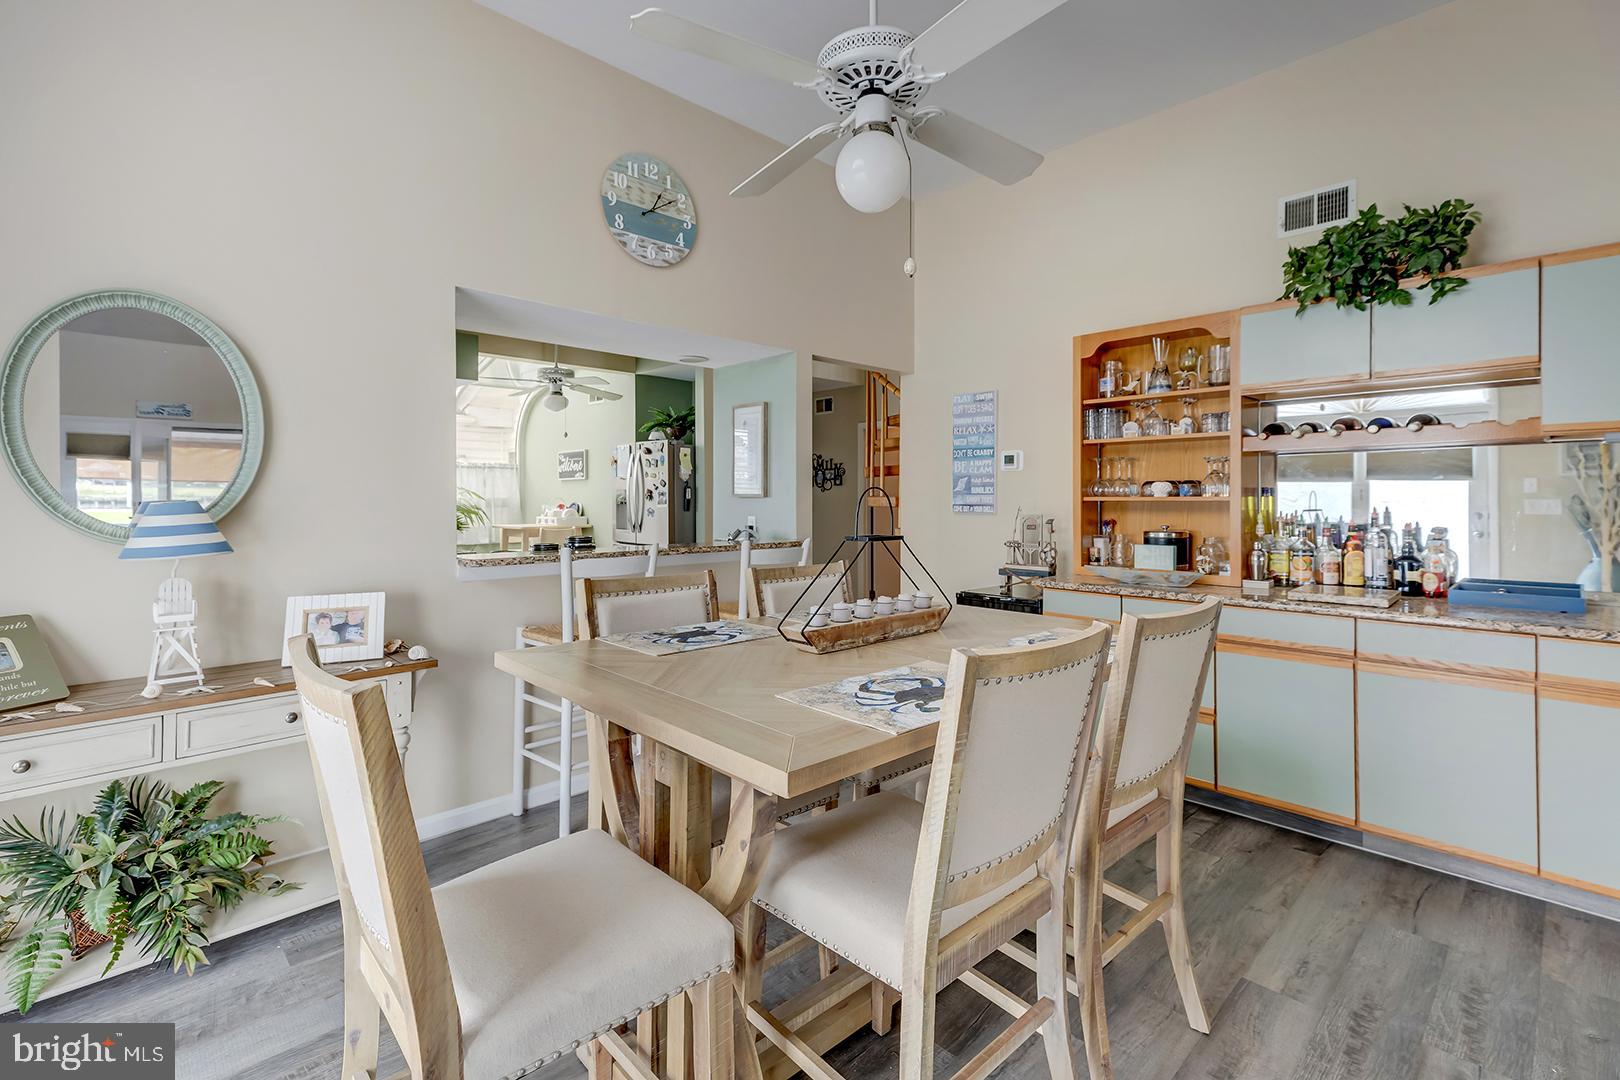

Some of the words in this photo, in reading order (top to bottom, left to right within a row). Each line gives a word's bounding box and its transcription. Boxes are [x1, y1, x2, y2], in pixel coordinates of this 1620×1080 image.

[627, 160, 640, 179] 11
[643, 162, 659, 180] 12
[613, 172, 628, 190] 10
[666, 175, 672, 190] 1
[607, 191, 617, 206] 9
[677, 193, 686, 209] 2
[614, 213, 624, 230] 8
[683, 214, 692, 230] 3
[629, 234, 639, 250] 7
[675, 232, 685, 248] 4
[646, 244, 656, 259] 6
[664, 244, 673, 259] 5
[20, 680, 37, 688] but
